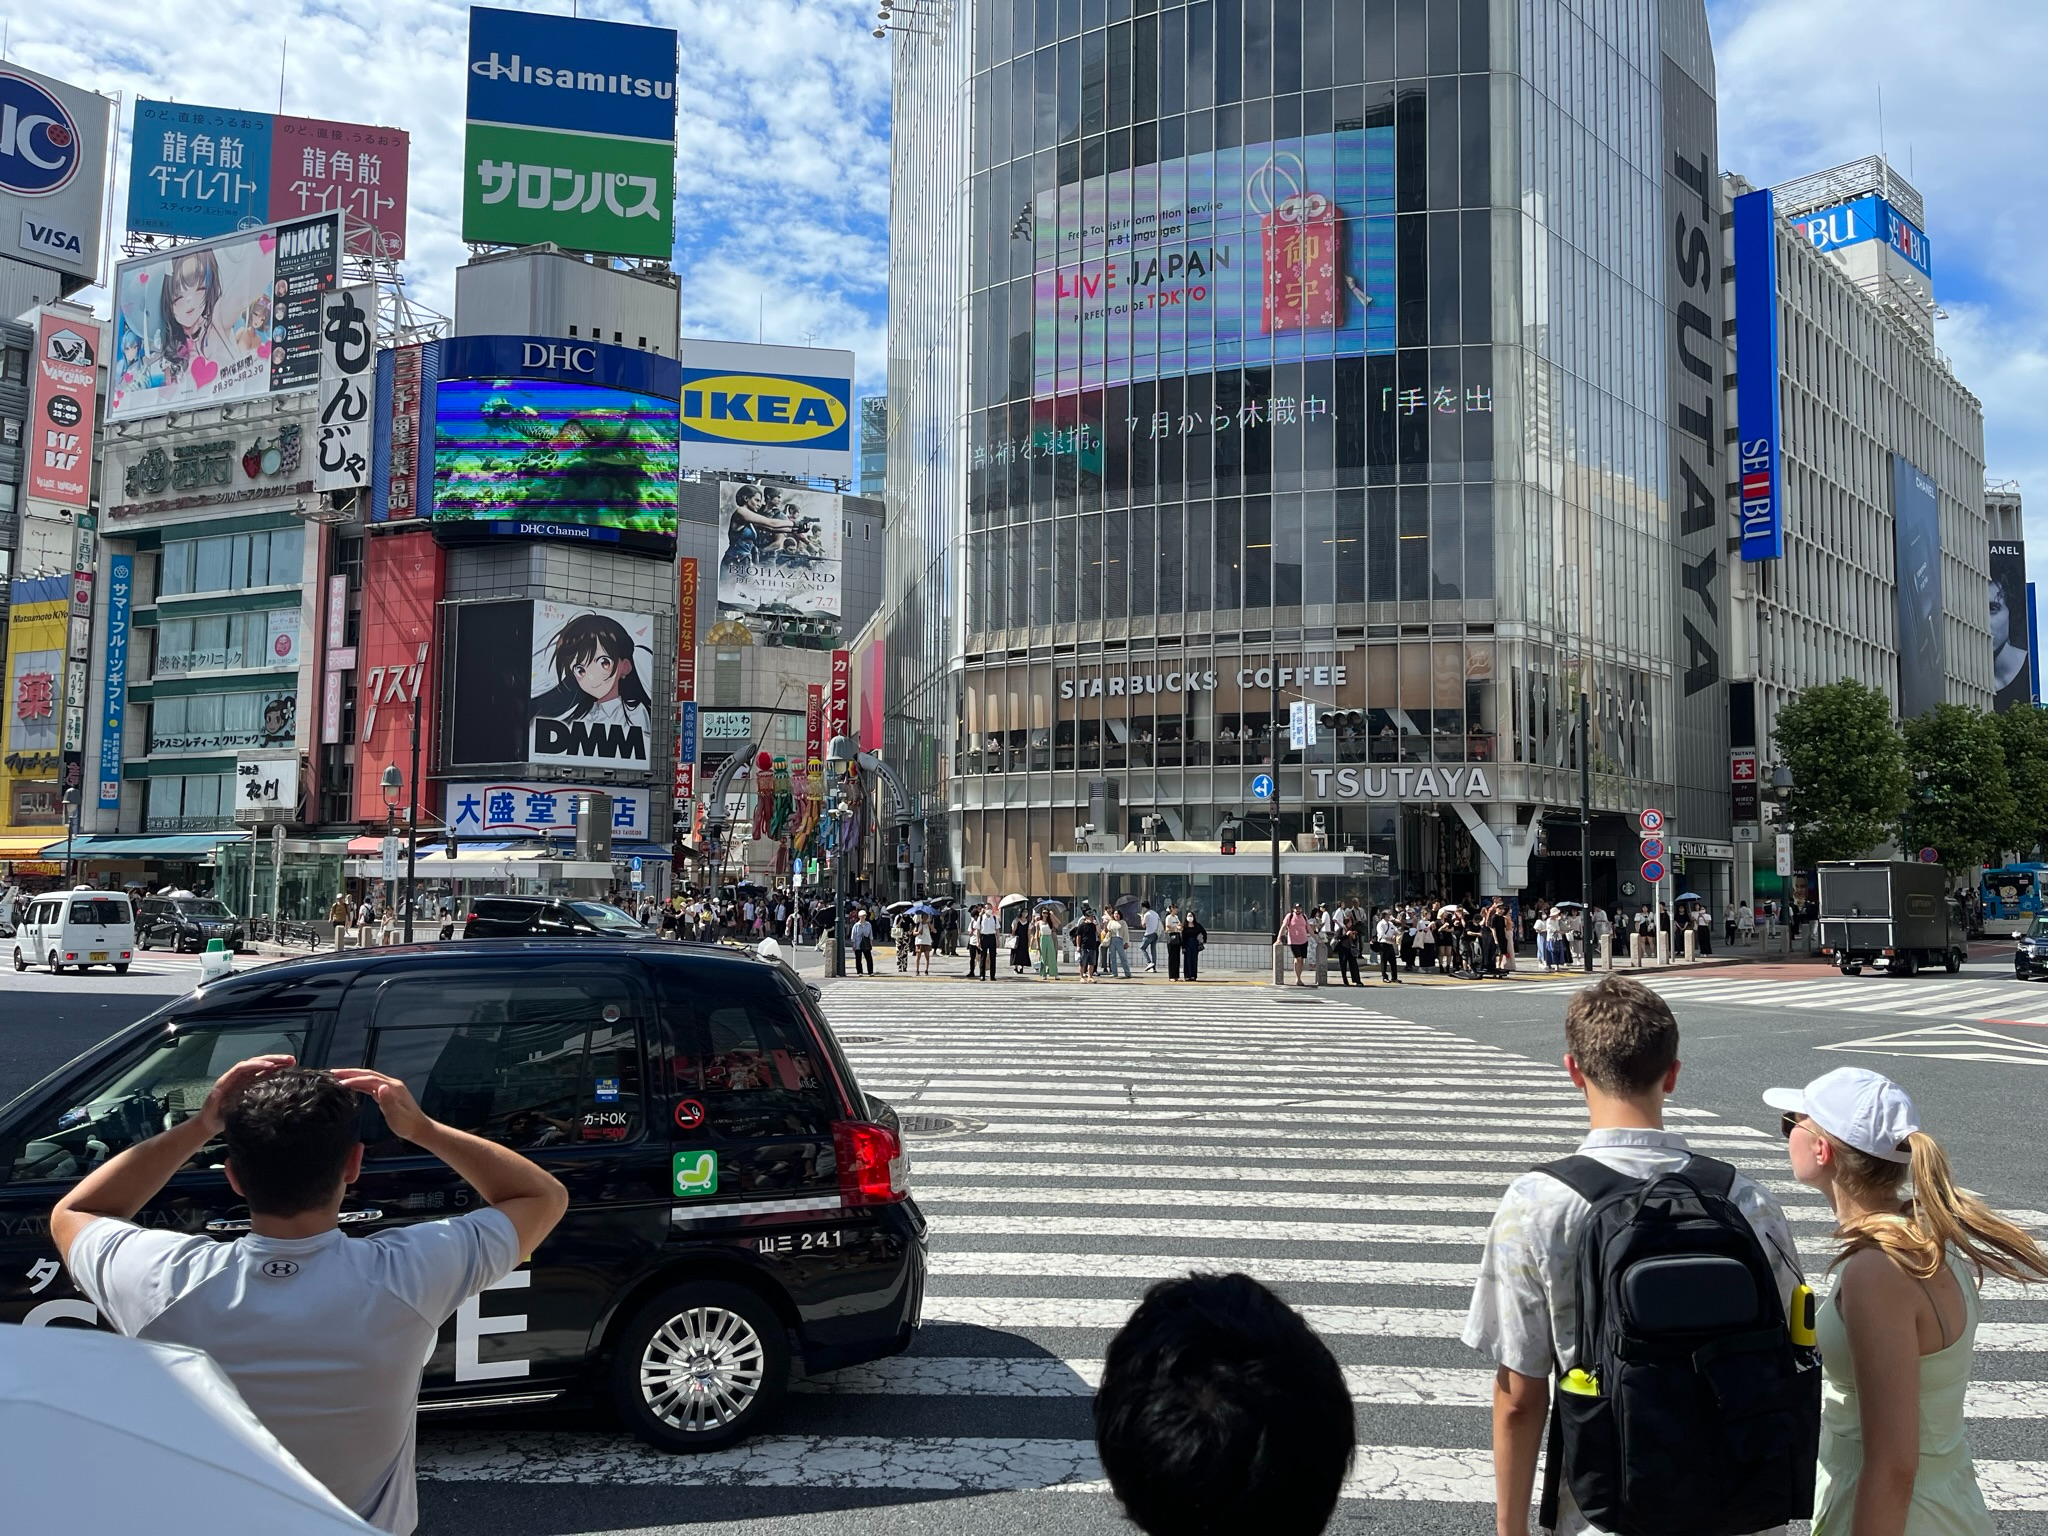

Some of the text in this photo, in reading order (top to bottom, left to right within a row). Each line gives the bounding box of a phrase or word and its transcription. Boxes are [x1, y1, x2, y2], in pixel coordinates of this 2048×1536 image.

[471, 52, 673, 101] Hisamitsu
[144, 109, 264, 131] のど、直接、うるおう
[283, 123, 401, 148] のど、直接、うるおう
[163, 131, 245, 169] 龍角散
[303, 146, 382, 185] 龍角散
[149, 165, 257, 204] ダイレクト
[289, 180, 396, 219] ダイレクト
[478, 159, 660, 222] サロンパス
[25, 221, 81, 254] VISA
[279, 223, 330, 259] NIKKE
[1068, 229, 1088, 241] Free
[1123, 209, 1181, 227] Inormtion
[1117, 234, 1123, 244] 8
[1058, 245, 1230, 299] LIVE JAPAN
[1283, 233, 1319, 310] 御守
[1074, 286, 1207, 323] PRFECT GUDE TOKYO
[522, 342, 597, 374] DHC
[319, 291, 372, 483] もんじゃ
[684, 390, 835, 428] IKEA
[1674, 151, 1719, 698] TSUTAYA
[47, 430, 80, 450] B1F
[968, 423, 1100, 471] 部補を逮捕。
[45, 450, 80, 471] B2F
[1741, 437, 1772, 541] SEIBU
[1915, 476, 1936, 499] CHANEL
[520, 523, 590, 538] DHC Channel
[1990, 546, 2019, 555] ANEL
[728, 564, 836, 583] BIOHAZARD
[736, 577, 776, 587] DEATH
[781, 583, 825, 591] ISLAND
[13, 612, 69, 624] Matsumoto KiYo
[682, 562, 694, 652] クスリのことなら
[109, 583, 128, 714] サマーフルーツギフト
[199, 651, 242, 667] クリニック
[17, 672, 54, 720] 薬
[833, 659, 847, 730] カラオケ
[1060, 665, 1347, 700] STARBUCKS COFFEE
[716, 715, 750, 725] れいわ
[1568, 685, 1647, 726] TUTAYA
[535, 717, 646, 760] DMM
[705, 727, 750, 737] クリニック
[1310, 766, 1492, 799] TSUTAYA
[1735, 761, 1752, 778] 本
[182, 818, 235, 828] フルーツパーラ
[1679, 841, 1708, 856] TSUTAYA
[584, 1112, 627, 1126] カードOK
[1, 1217, 50, 1236] YAM
[759, 1231, 841, 1254] 山三 241
